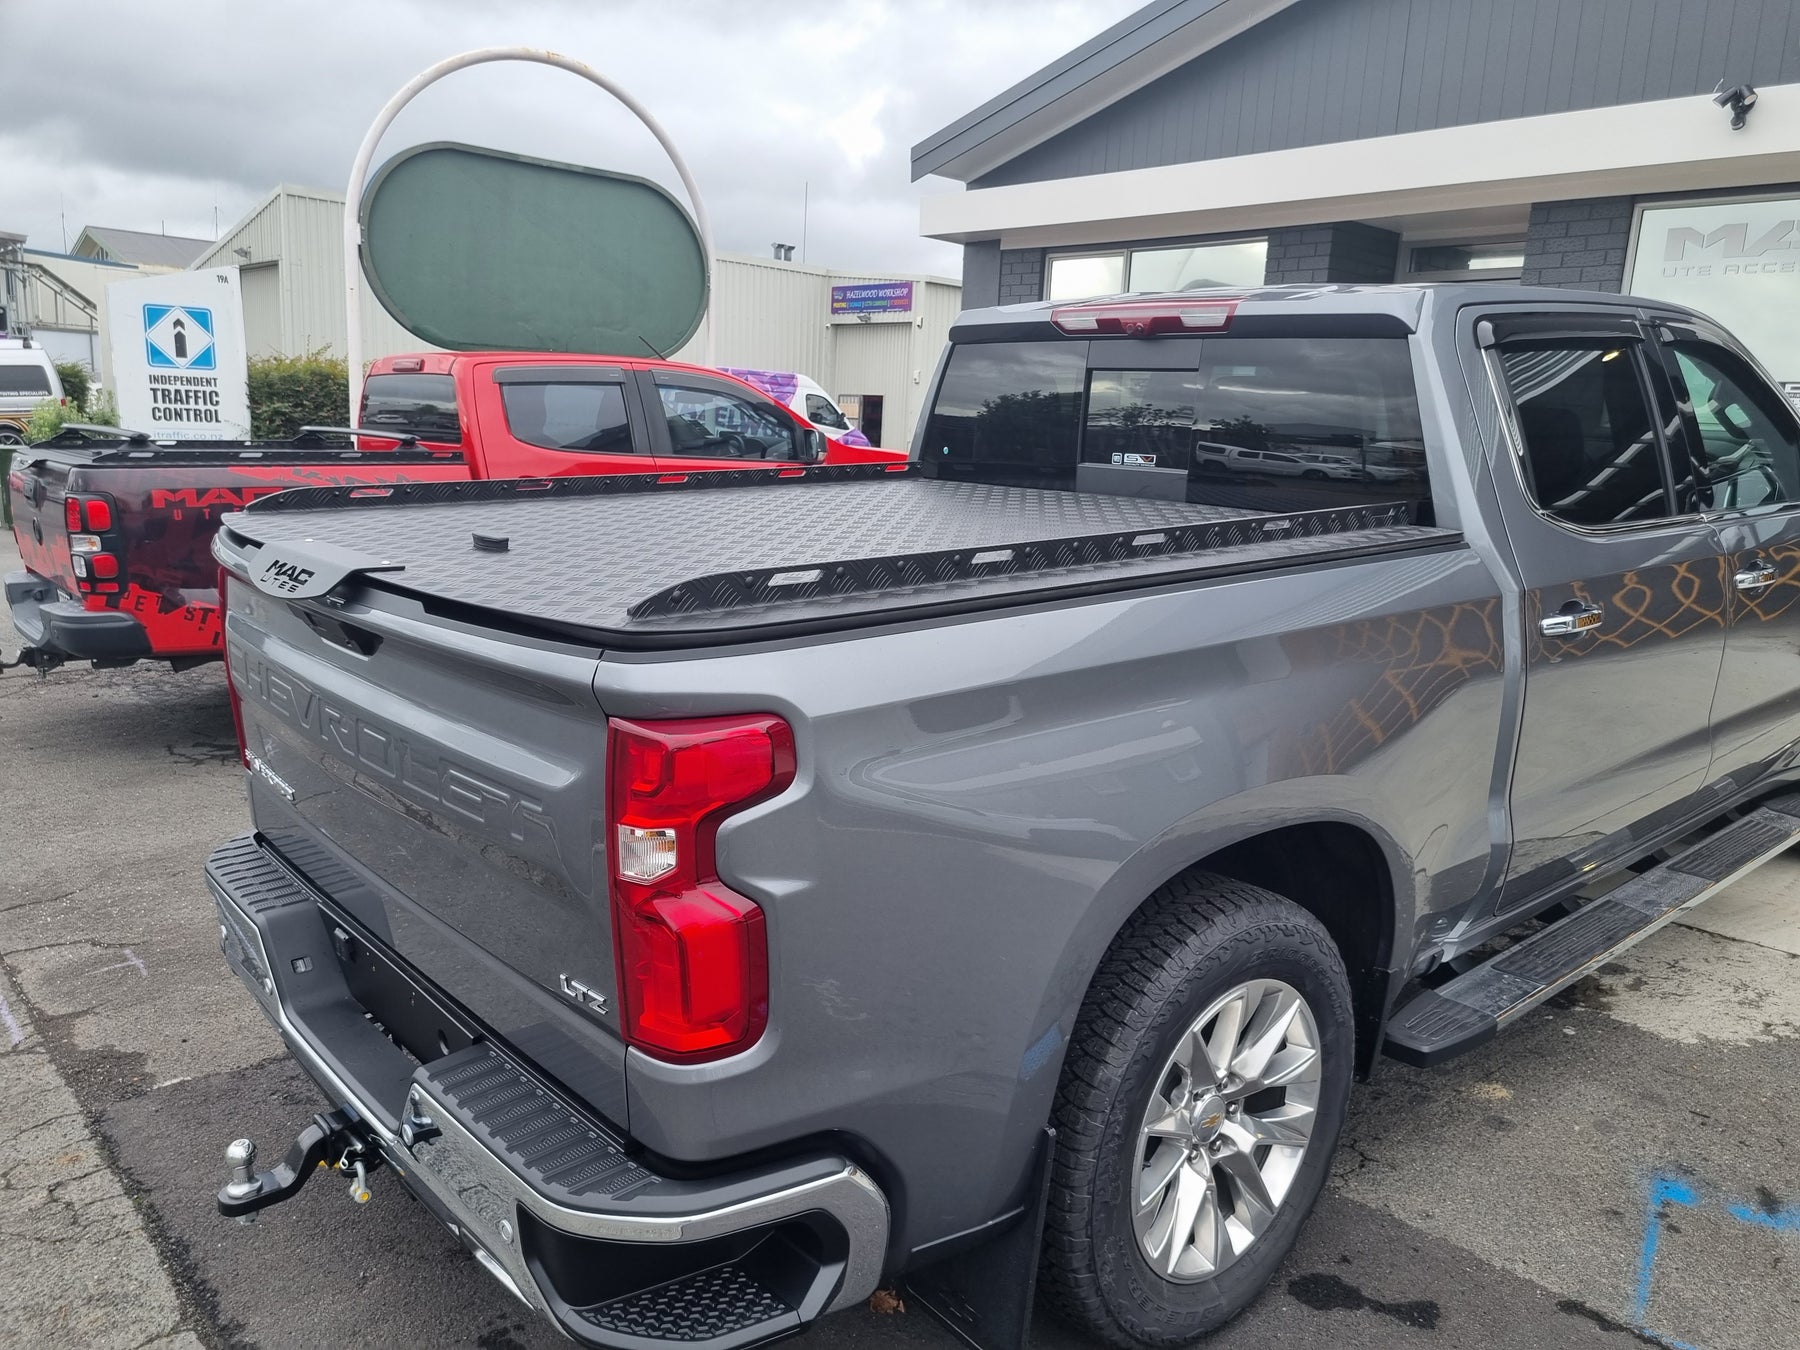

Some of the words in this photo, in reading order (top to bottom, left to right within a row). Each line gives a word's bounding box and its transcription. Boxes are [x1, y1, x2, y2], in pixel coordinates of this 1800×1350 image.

[1663, 265, 1712, 278] UTE
[1723, 261, 1800, 276] ACCE
[216, 274, 229, 284] 19A
[846, 289, 877, 299] HAZELWOOD
[878, 287, 908, 298] WORKSHOP
[149, 374, 218, 388] INDEPENDENT
[150, 388, 220, 406] TRAFFIC
[152, 406, 221, 423] CONTROL
[153, 431, 223, 440] itraffic.co.nz
[265, 560, 315, 585] MAC
[560, 973, 608, 1014] LTZ
